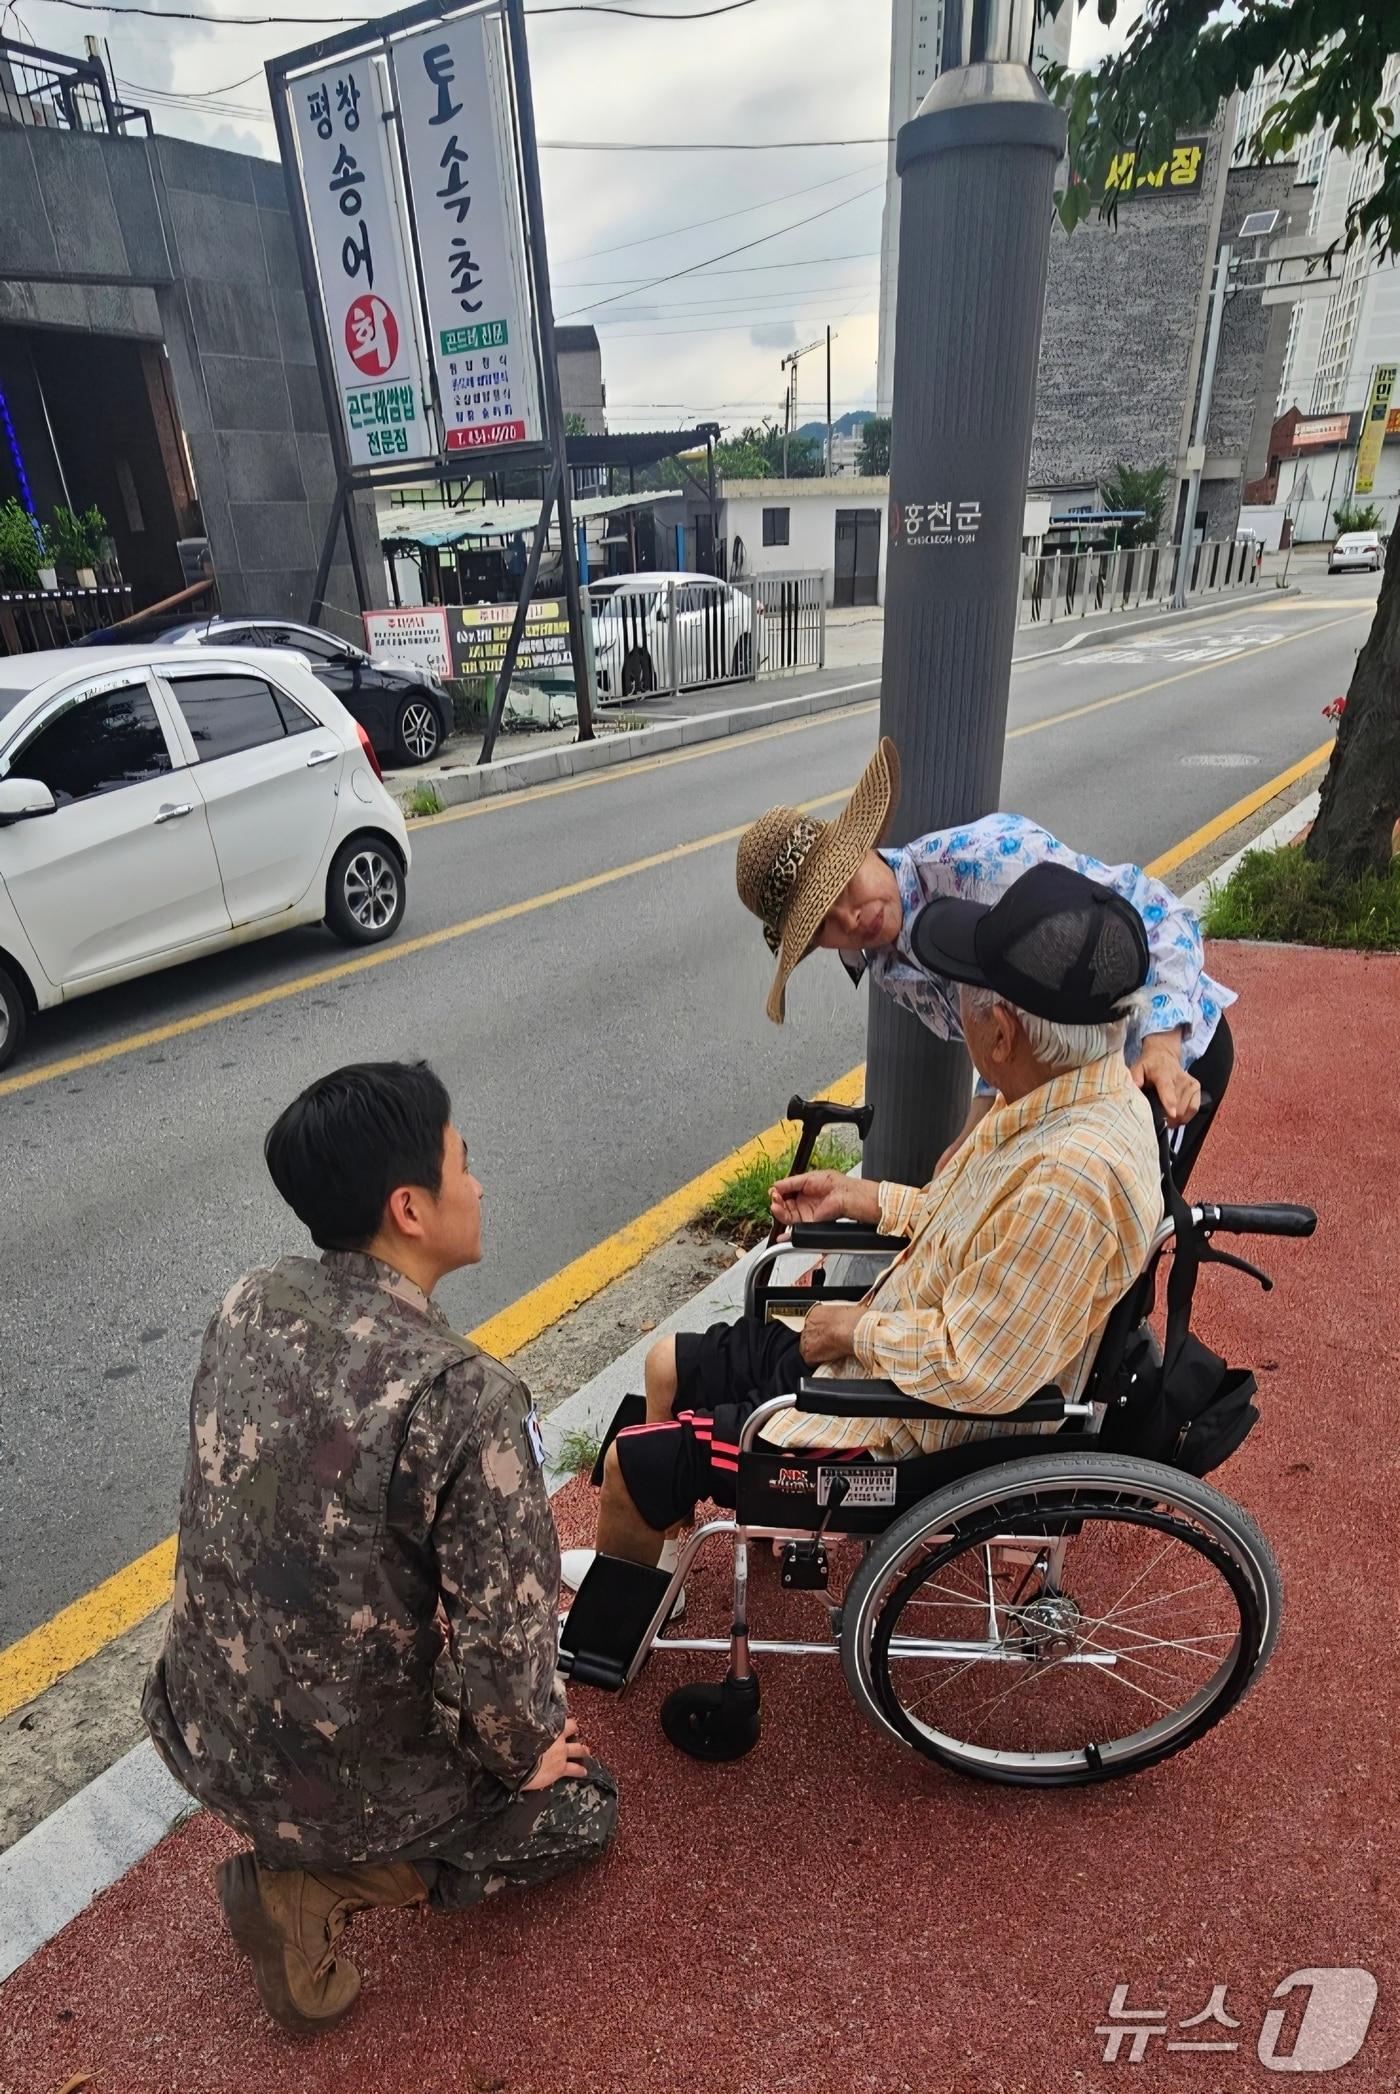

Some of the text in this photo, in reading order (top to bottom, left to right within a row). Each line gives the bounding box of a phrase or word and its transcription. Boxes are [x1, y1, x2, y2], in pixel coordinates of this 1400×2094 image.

[308, 73, 361, 140] 평창
[422, 43, 483, 313] 토속촌
[905, 501, 982, 534] 홍천군
